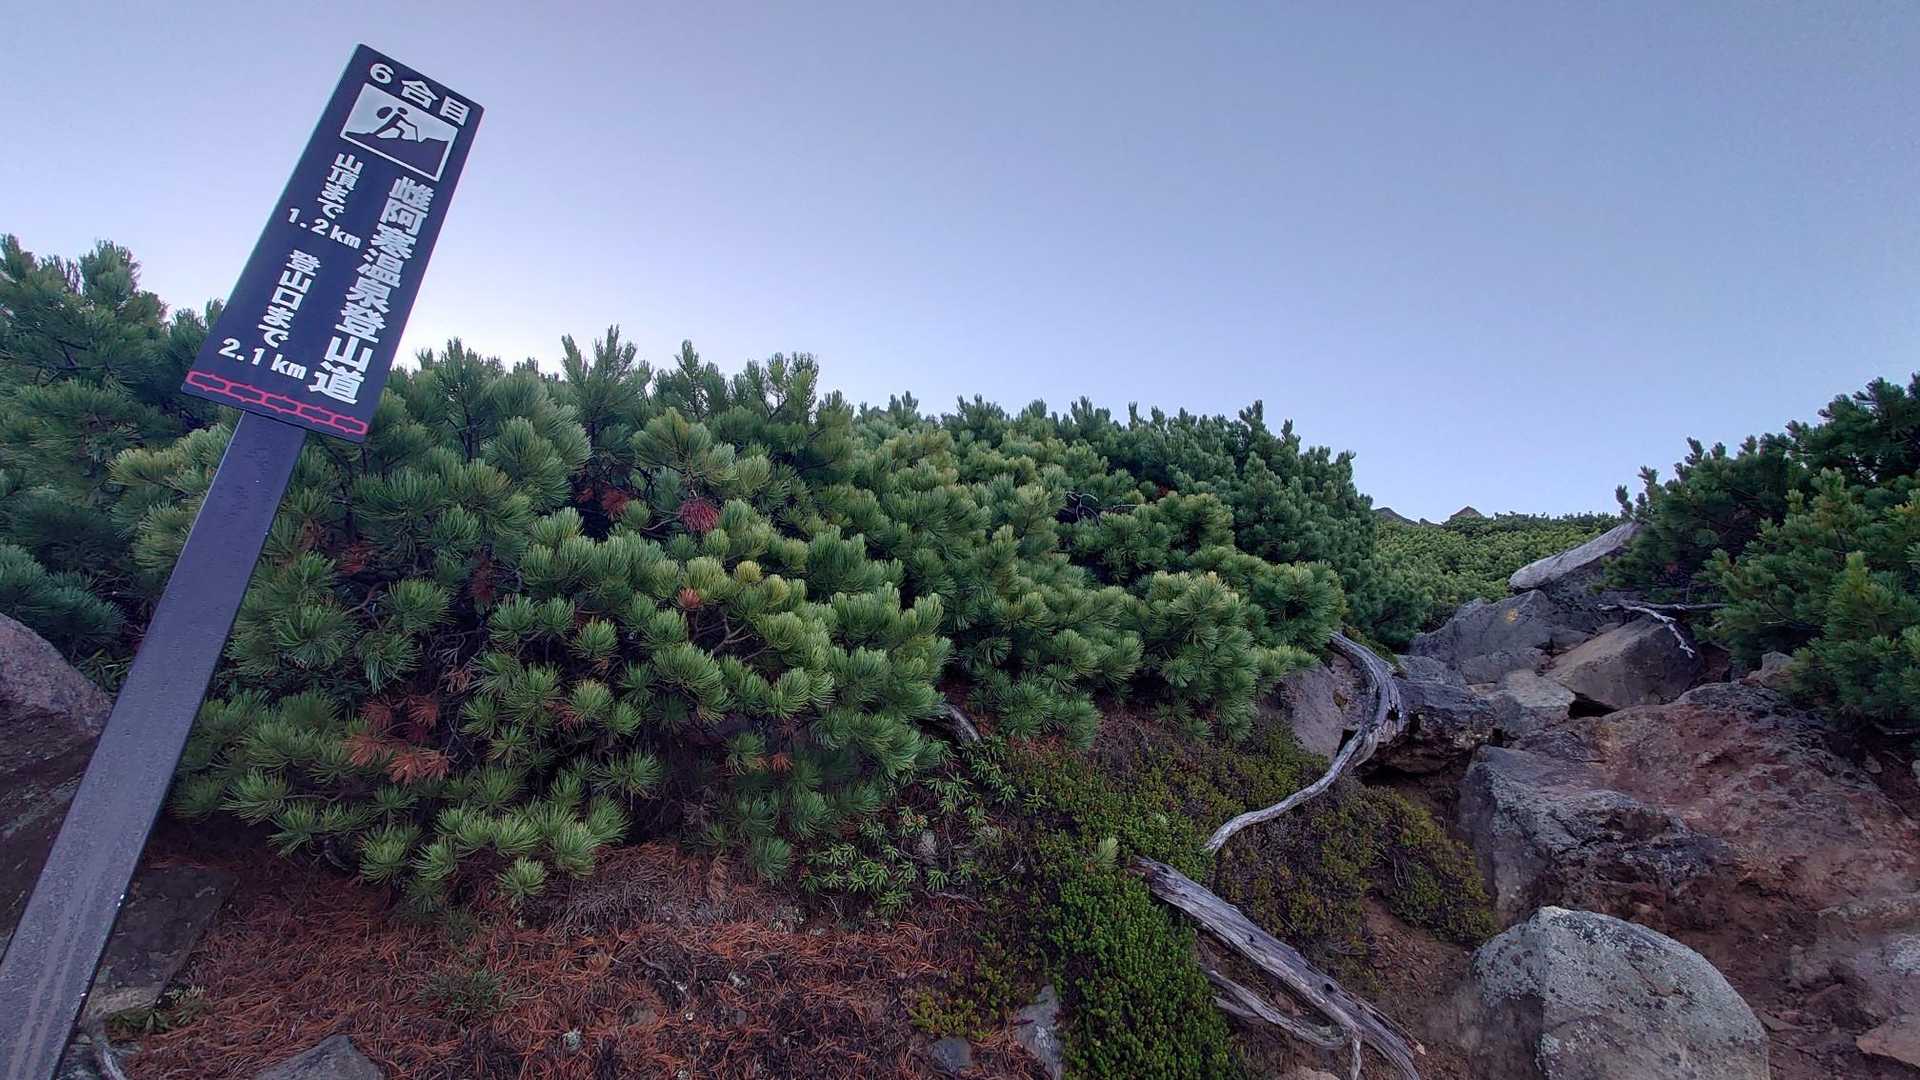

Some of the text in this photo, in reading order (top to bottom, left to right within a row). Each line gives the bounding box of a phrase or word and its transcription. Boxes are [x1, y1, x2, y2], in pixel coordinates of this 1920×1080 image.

[317, 153, 364, 220] 山頂まで
[258, 249, 321, 348] 登山口まで
[308, 176, 435, 405] 雌阿寒温泉登山道
